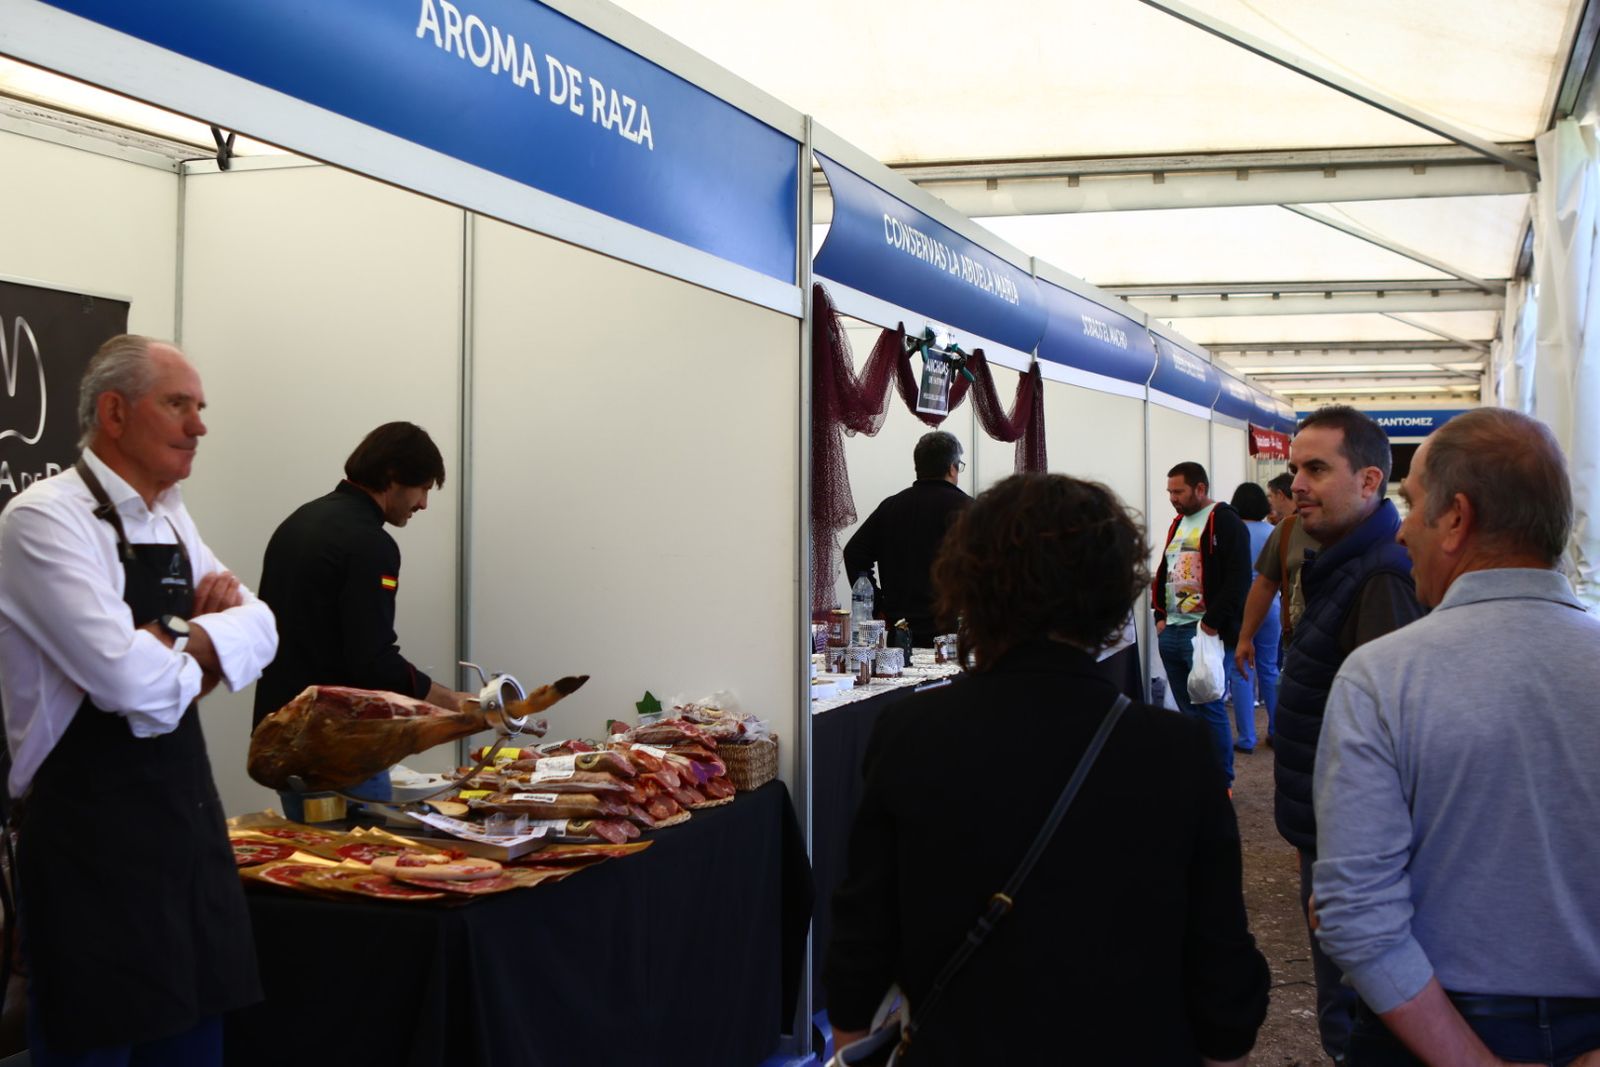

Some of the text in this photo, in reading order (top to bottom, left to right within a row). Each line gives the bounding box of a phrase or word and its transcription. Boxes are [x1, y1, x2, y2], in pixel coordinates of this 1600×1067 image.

[416, 0, 654, 151] AROMA DE RAZA
[883, 213, 947, 271] CONSERVAS
[945, 246, 961, 277] LA
[960, 254, 994, 296] ABUELA
[1377, 416, 1433, 427] SANTOMEZ
